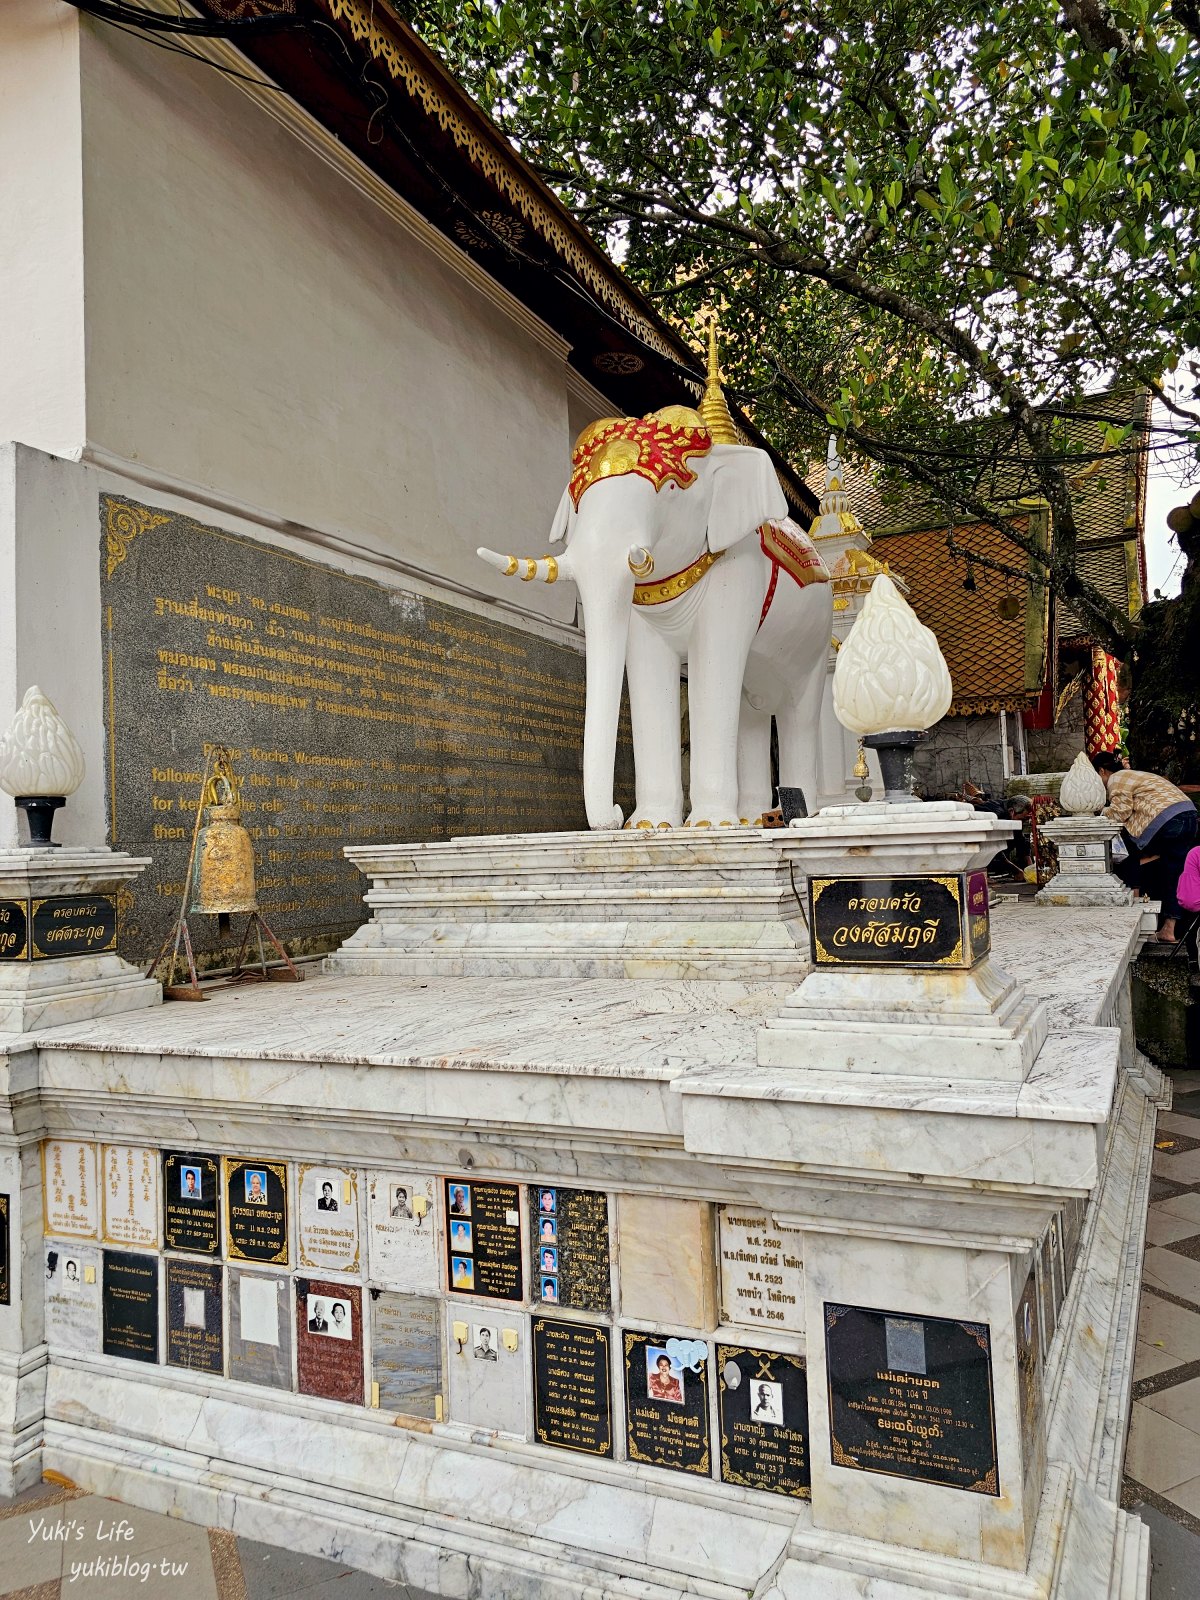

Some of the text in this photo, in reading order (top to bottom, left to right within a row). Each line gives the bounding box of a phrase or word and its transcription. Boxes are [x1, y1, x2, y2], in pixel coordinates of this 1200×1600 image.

[151, 795, 174, 811] for
[153, 823, 185, 839] then
[848, 892, 922, 913] ครอบครัว
[53, 903, 98, 919] ครอบครัว
[832, 918, 941, 949] วงศ์สมฤดี
[763, 1239, 782, 1249] 2502
[764, 1274, 783, 1285] 2523
[766, 1310, 785, 1321] 2546
[906, 1387, 919, 1399] 104
[789, 1444, 804, 1455] 2523
[752, 1449, 757, 1458] 6
[789, 1456, 805, 1467] 2546
[768, 1464, 777, 1473] 23
